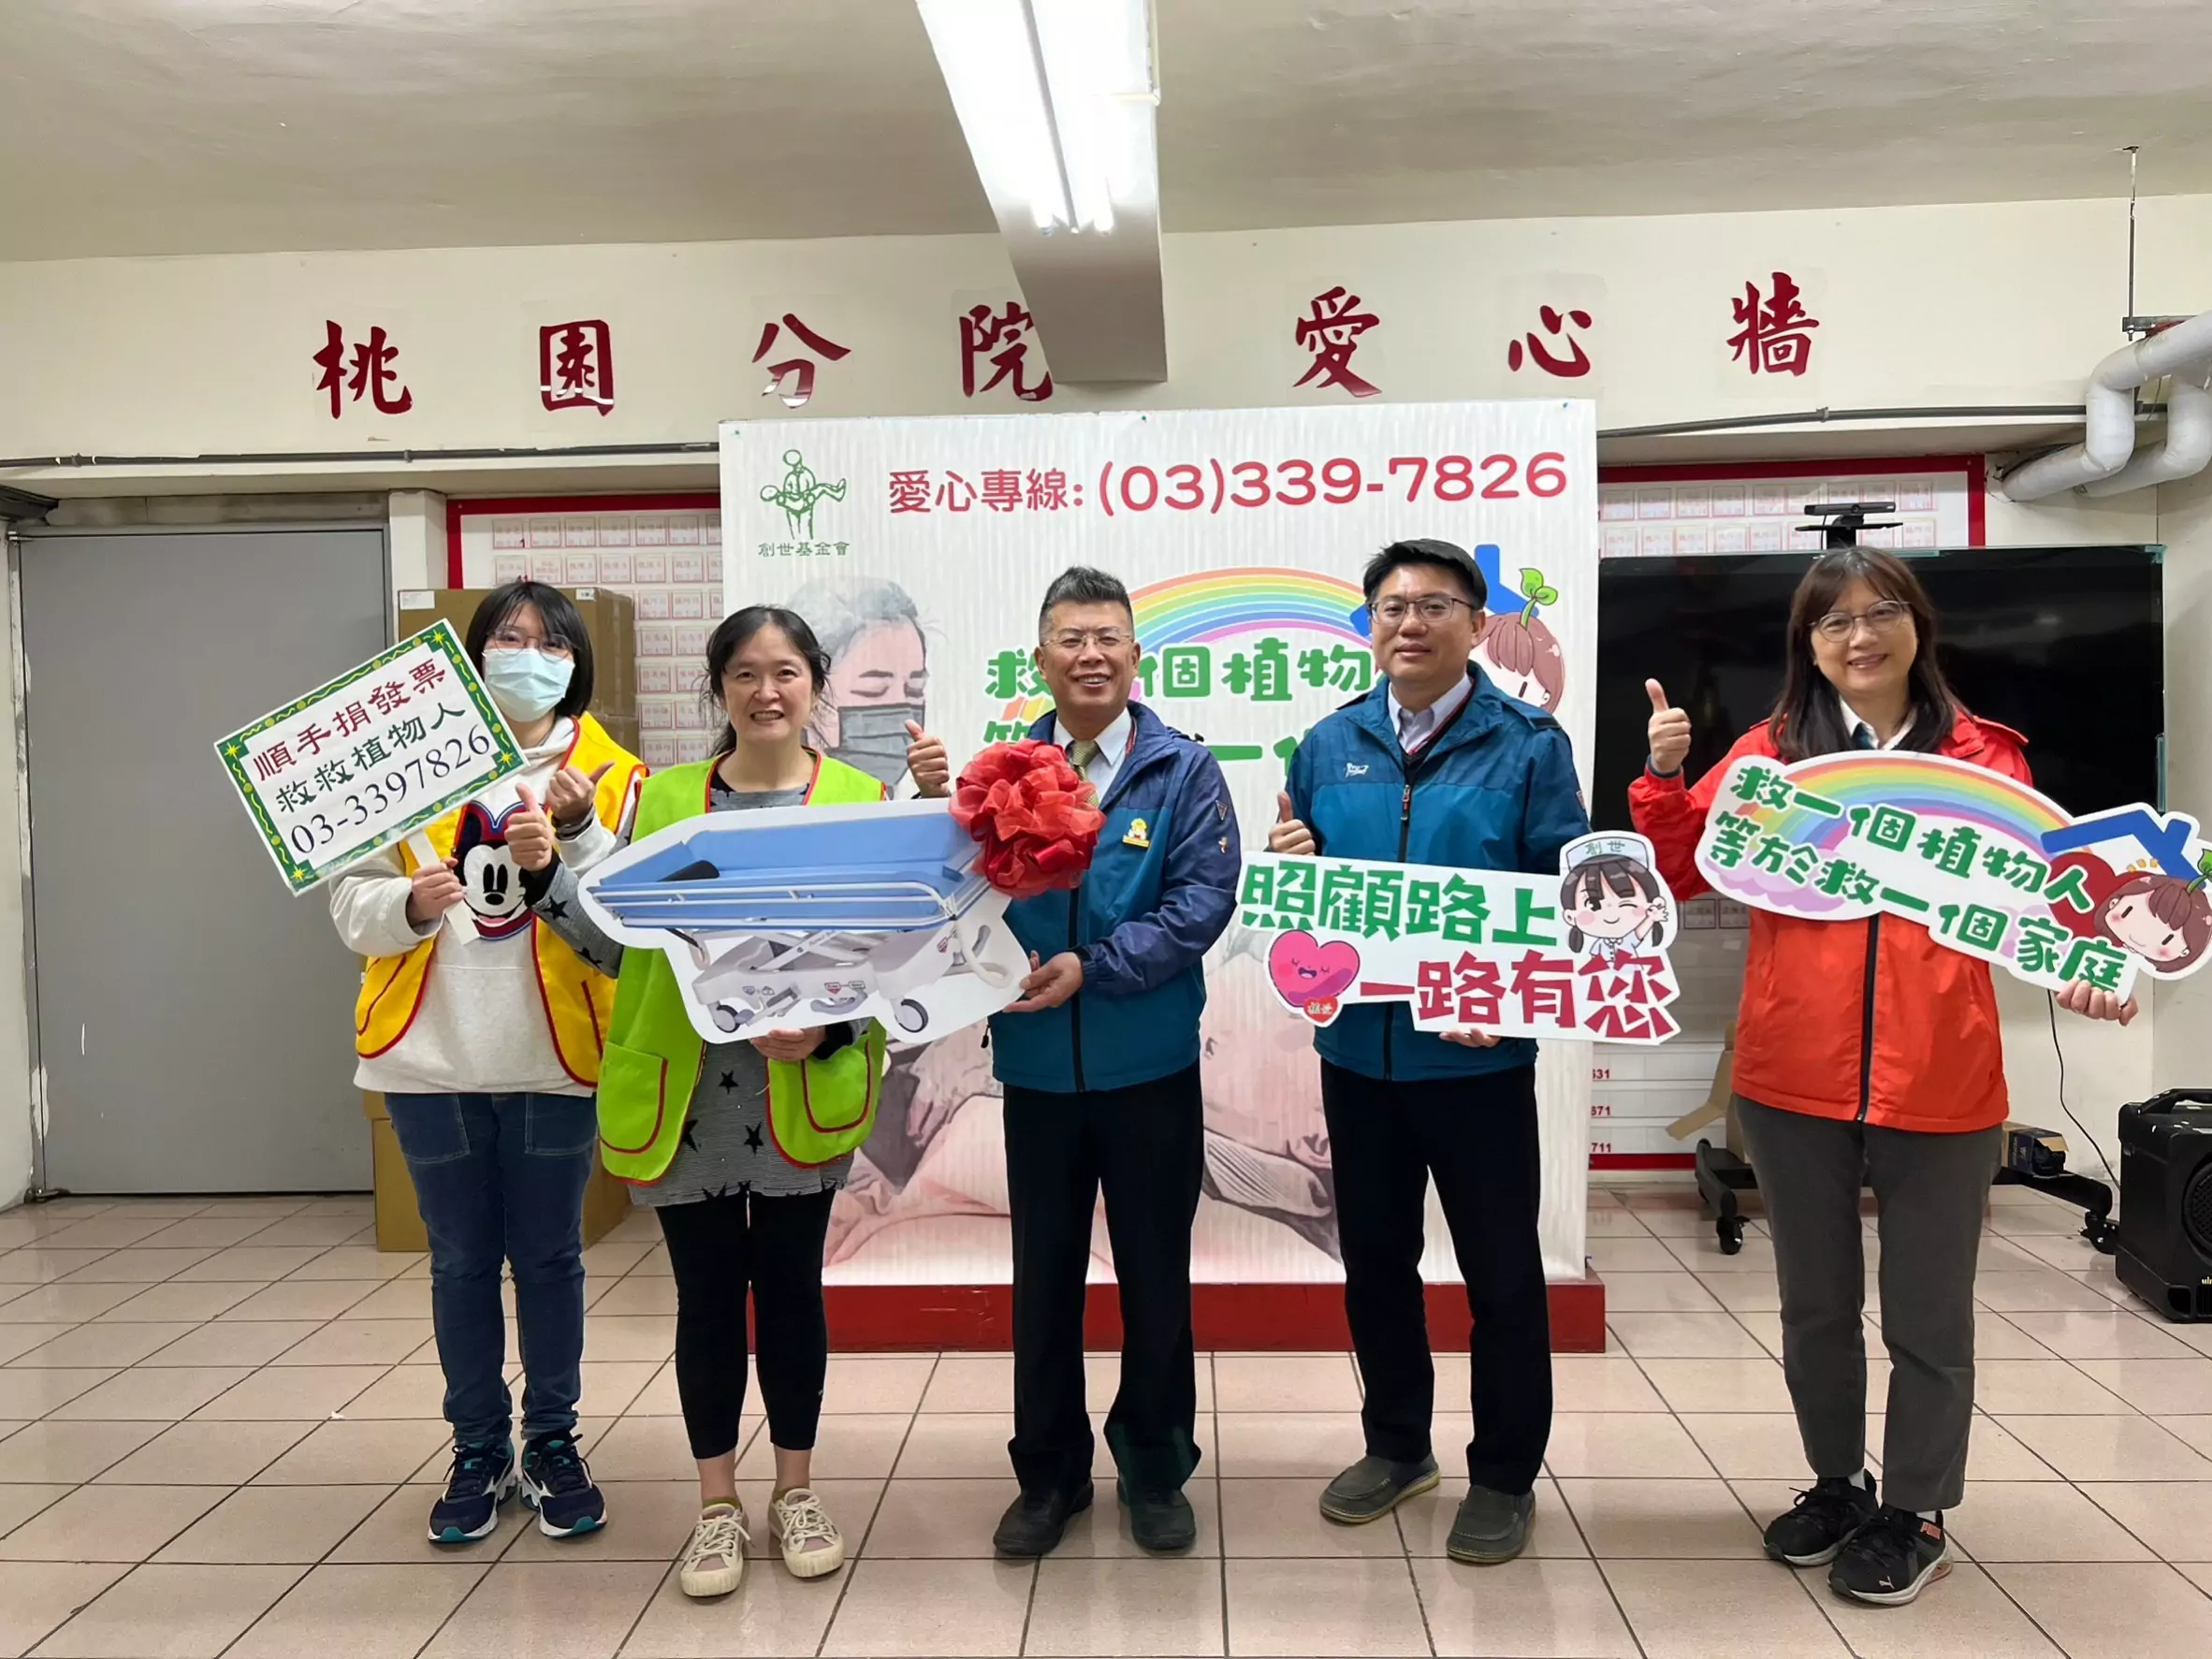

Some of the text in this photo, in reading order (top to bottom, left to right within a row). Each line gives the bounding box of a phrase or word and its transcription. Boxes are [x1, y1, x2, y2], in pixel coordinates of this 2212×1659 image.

[758, 541, 850, 558] 創世基金會
[254, 659, 445, 780] 順手捐發票
[276, 702, 466, 813] 救救植物人
[290, 724, 490, 854] 03-3397826
[1731, 764, 2095, 914] 救一個植物人
[1241, 861, 1558, 946] 照顧路上
[1709, 810, 2128, 993] 等於救一個家庭
[1360, 949, 1675, 1040] 一路有您
[1592, 1142, 1611, 1152] 711
